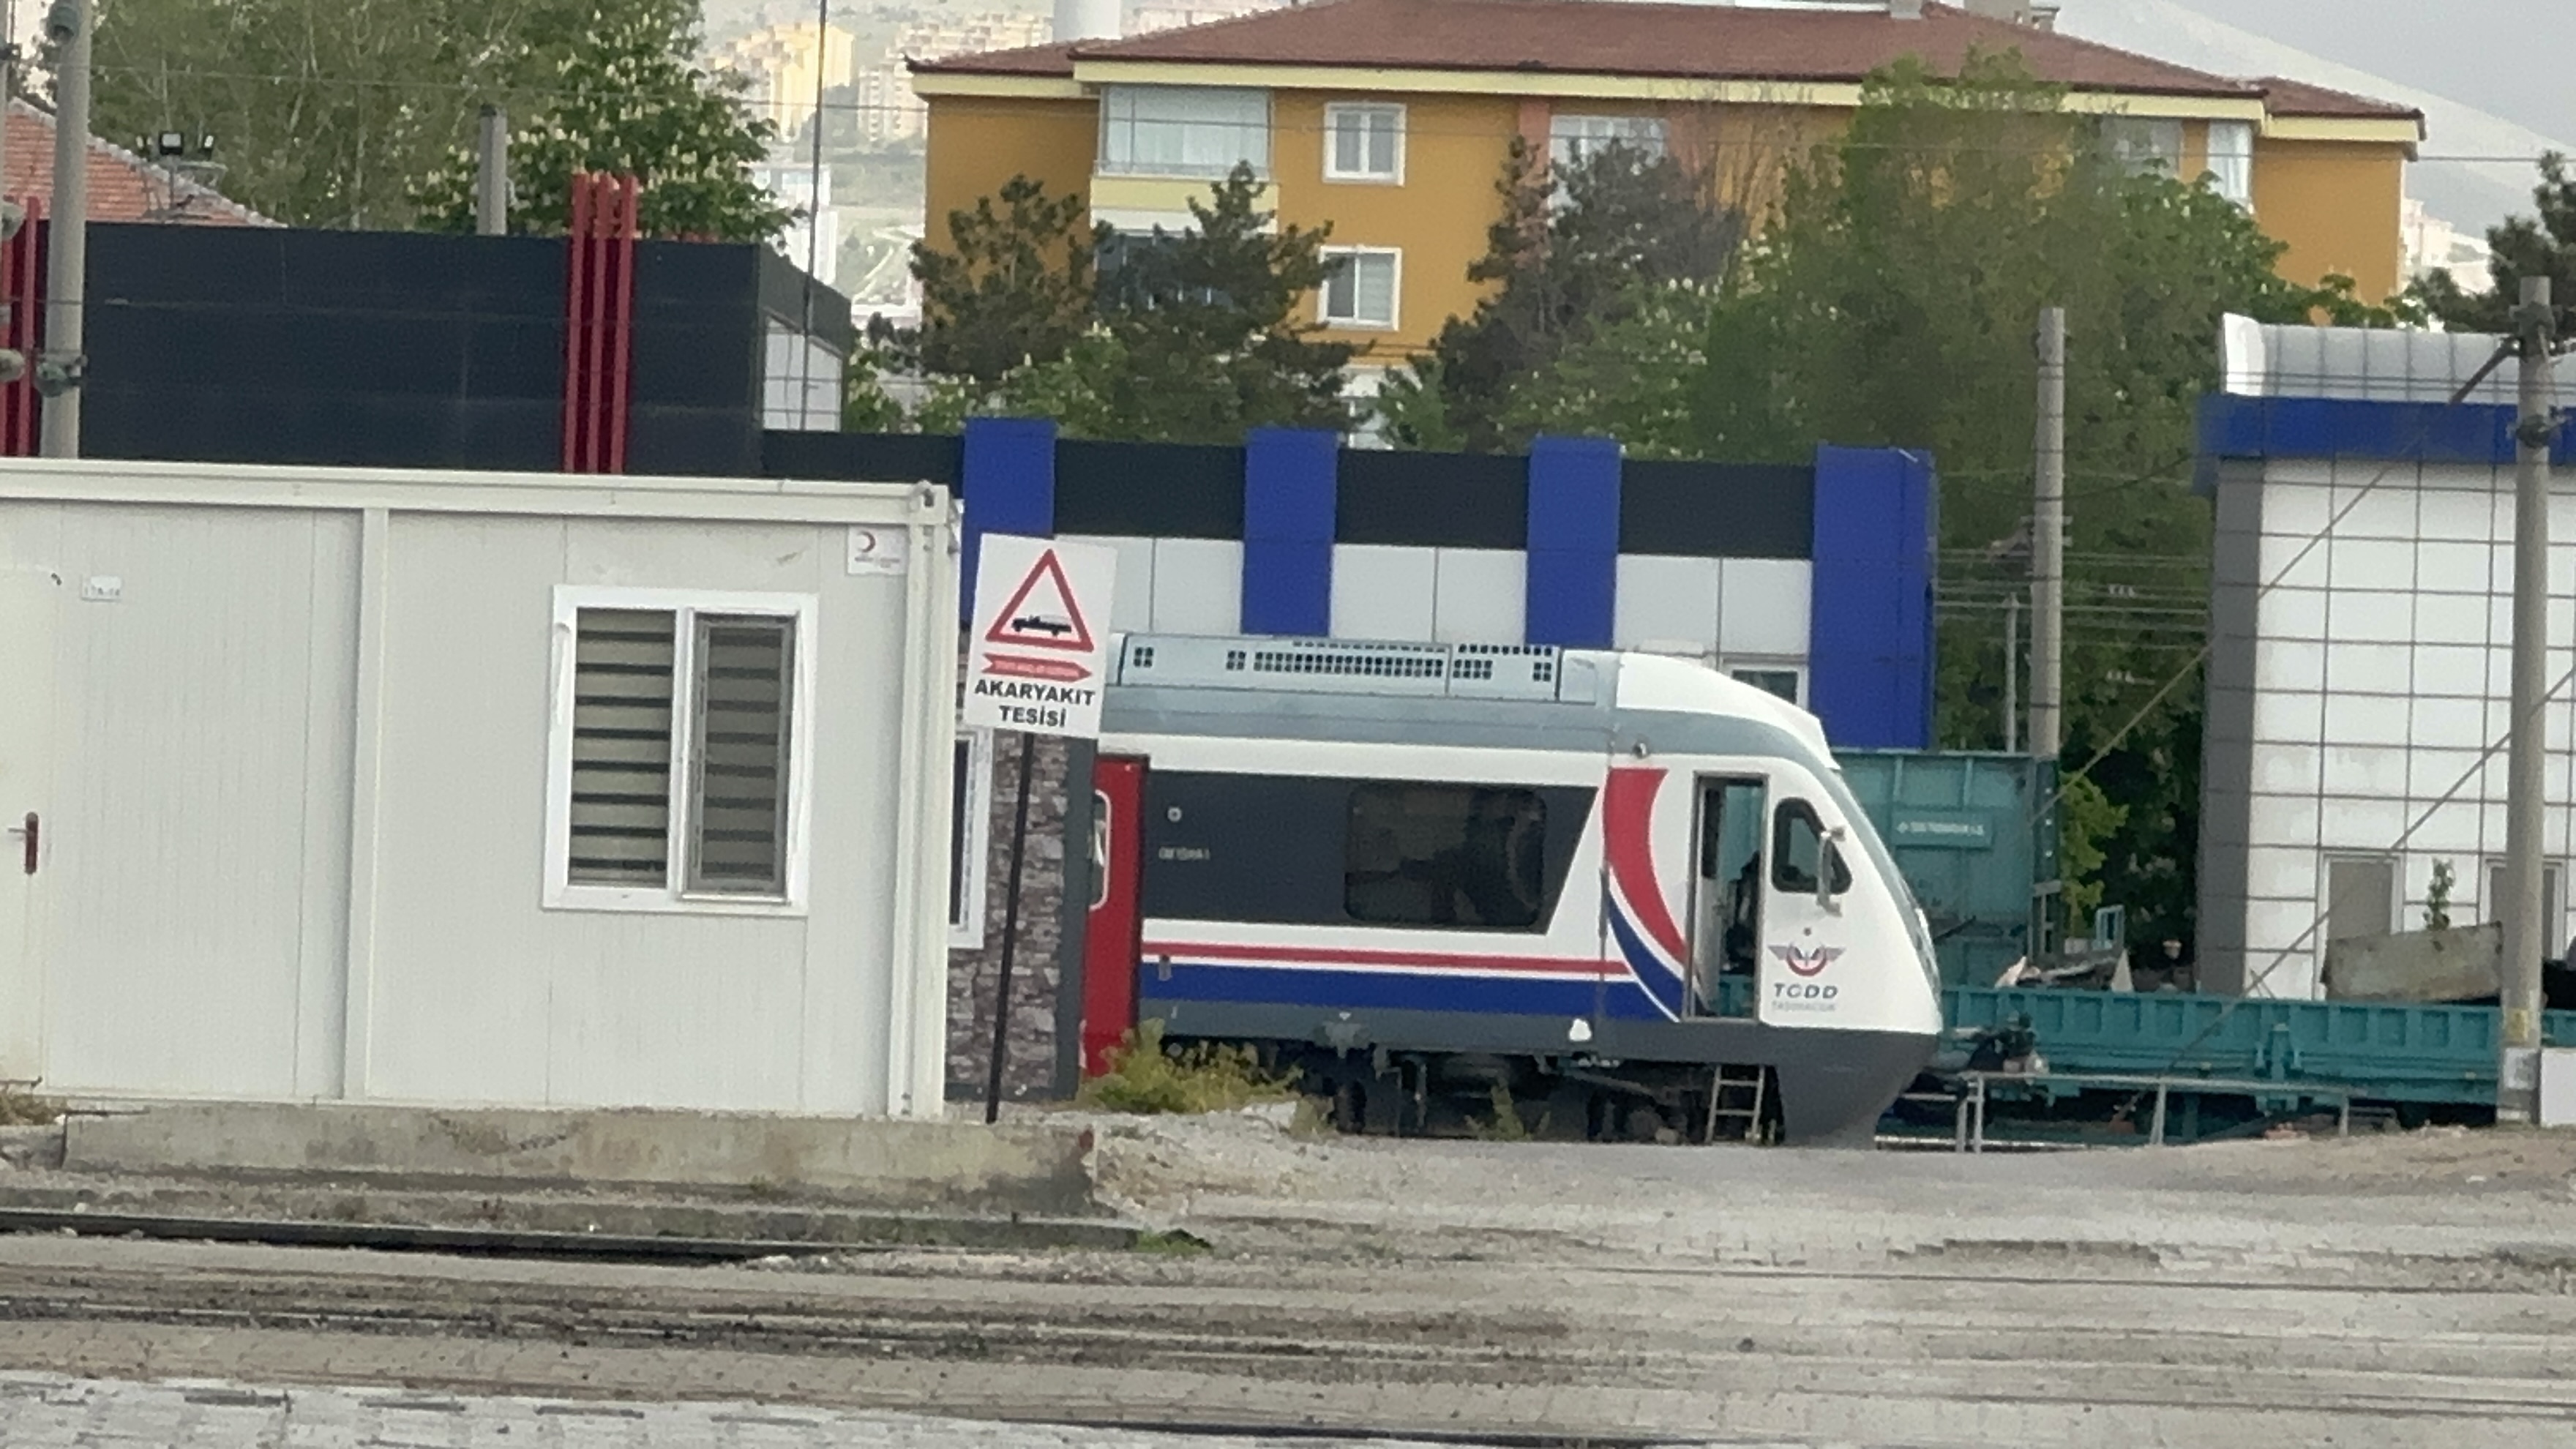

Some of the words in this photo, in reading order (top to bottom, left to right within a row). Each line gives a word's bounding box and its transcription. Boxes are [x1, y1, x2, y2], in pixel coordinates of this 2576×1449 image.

[975, 679, 1096, 705] AKARYAKIT
[999, 705, 1066, 727] TESİSİ
[1774, 983, 1838, 999] TCDD
